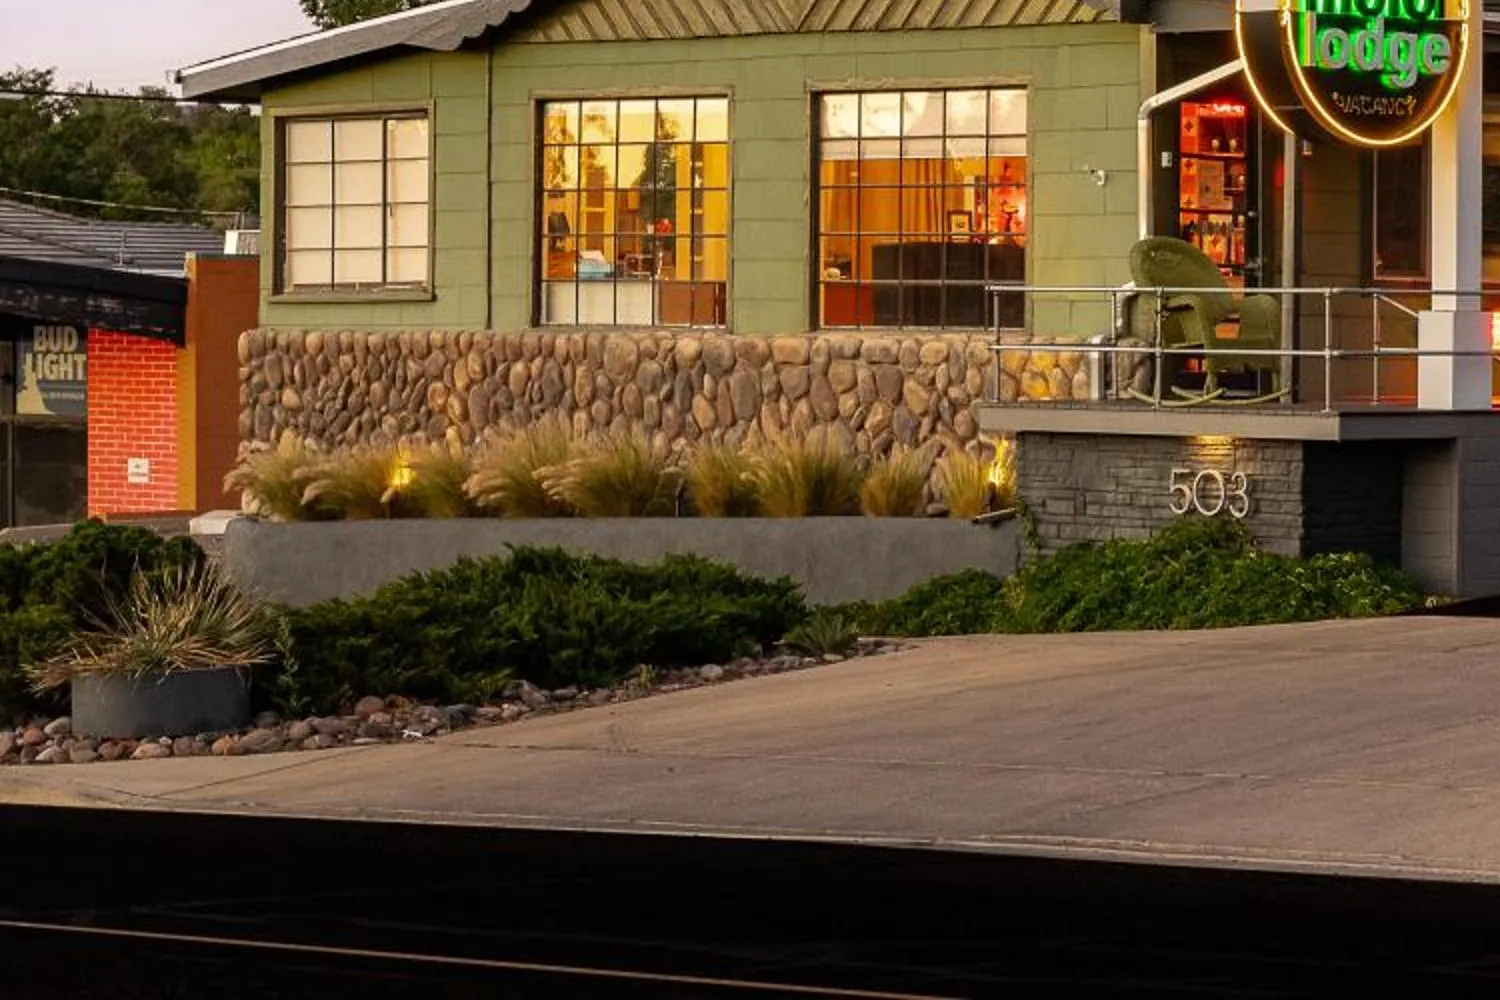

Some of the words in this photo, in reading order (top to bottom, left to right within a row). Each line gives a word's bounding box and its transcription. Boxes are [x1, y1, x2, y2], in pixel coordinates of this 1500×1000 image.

[1303, 9, 1451, 88] lodge
[1334, 93, 1417, 116] VACANCY
[33, 325, 79, 352] BUD
[24, 352, 87, 380] LIGHT
[1169, 469, 1249, 518] 503
